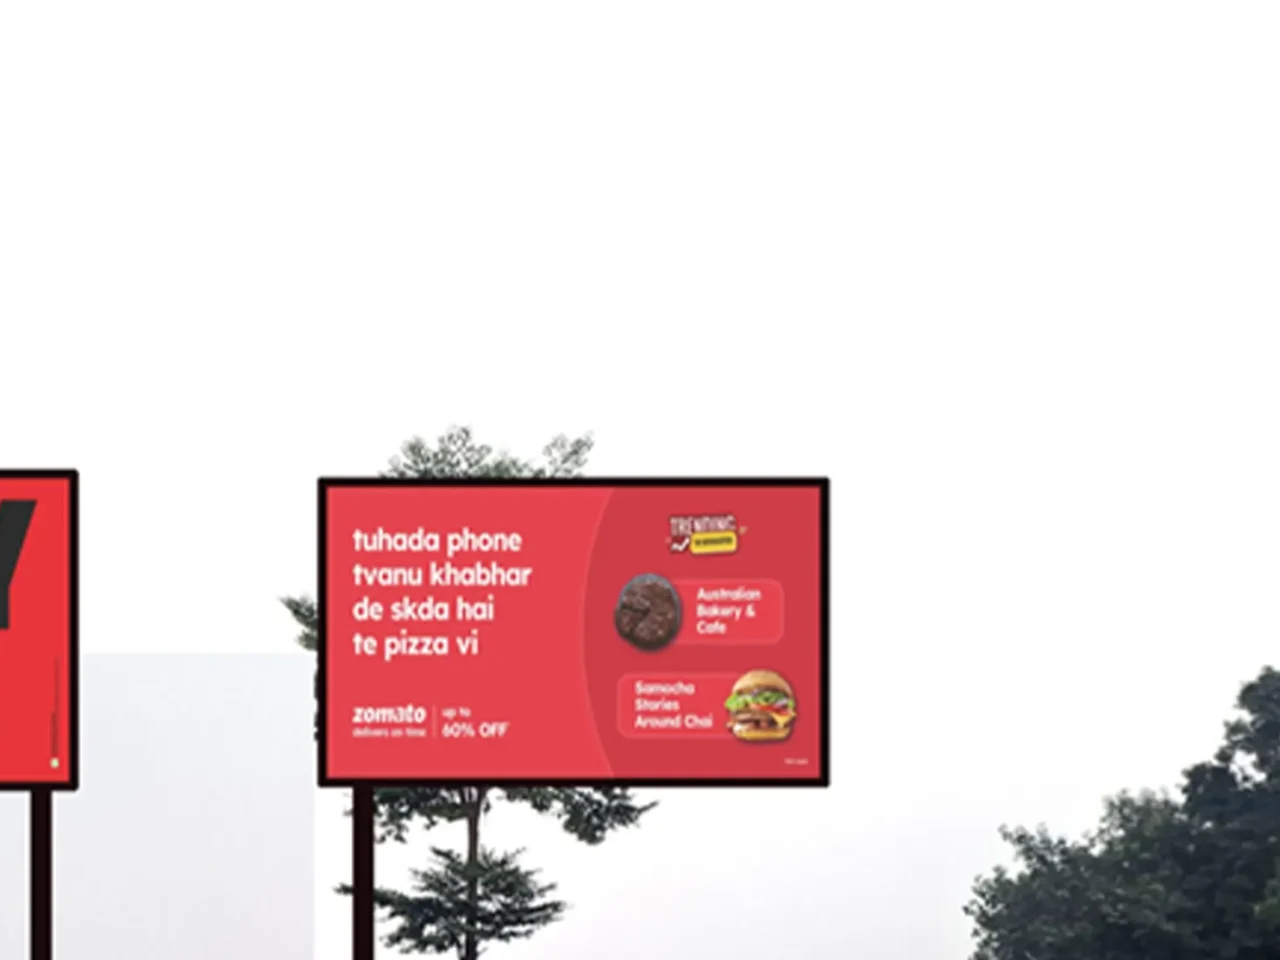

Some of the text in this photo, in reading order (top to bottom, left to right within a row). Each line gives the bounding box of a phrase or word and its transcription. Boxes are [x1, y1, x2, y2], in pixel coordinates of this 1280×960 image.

[669, 514, 737, 537] TRENDING
[352, 526, 522, 559] tuhada phone
[352, 561, 532, 586] tvanu khabhar
[696, 586, 762, 602] Australian
[352, 593, 495, 621] de skda hai
[696, 603, 756, 621] Bakery &
[696, 620, 727, 635] Cafe
[352, 628, 479, 662] te pizza vi
[635, 680, 696, 697] Samocha
[352, 703, 427, 724] zomato
[635, 696, 681, 713] Stories
[441, 721, 511, 739] 60% OFF
[634, 713, 714, 730] Around Chai
